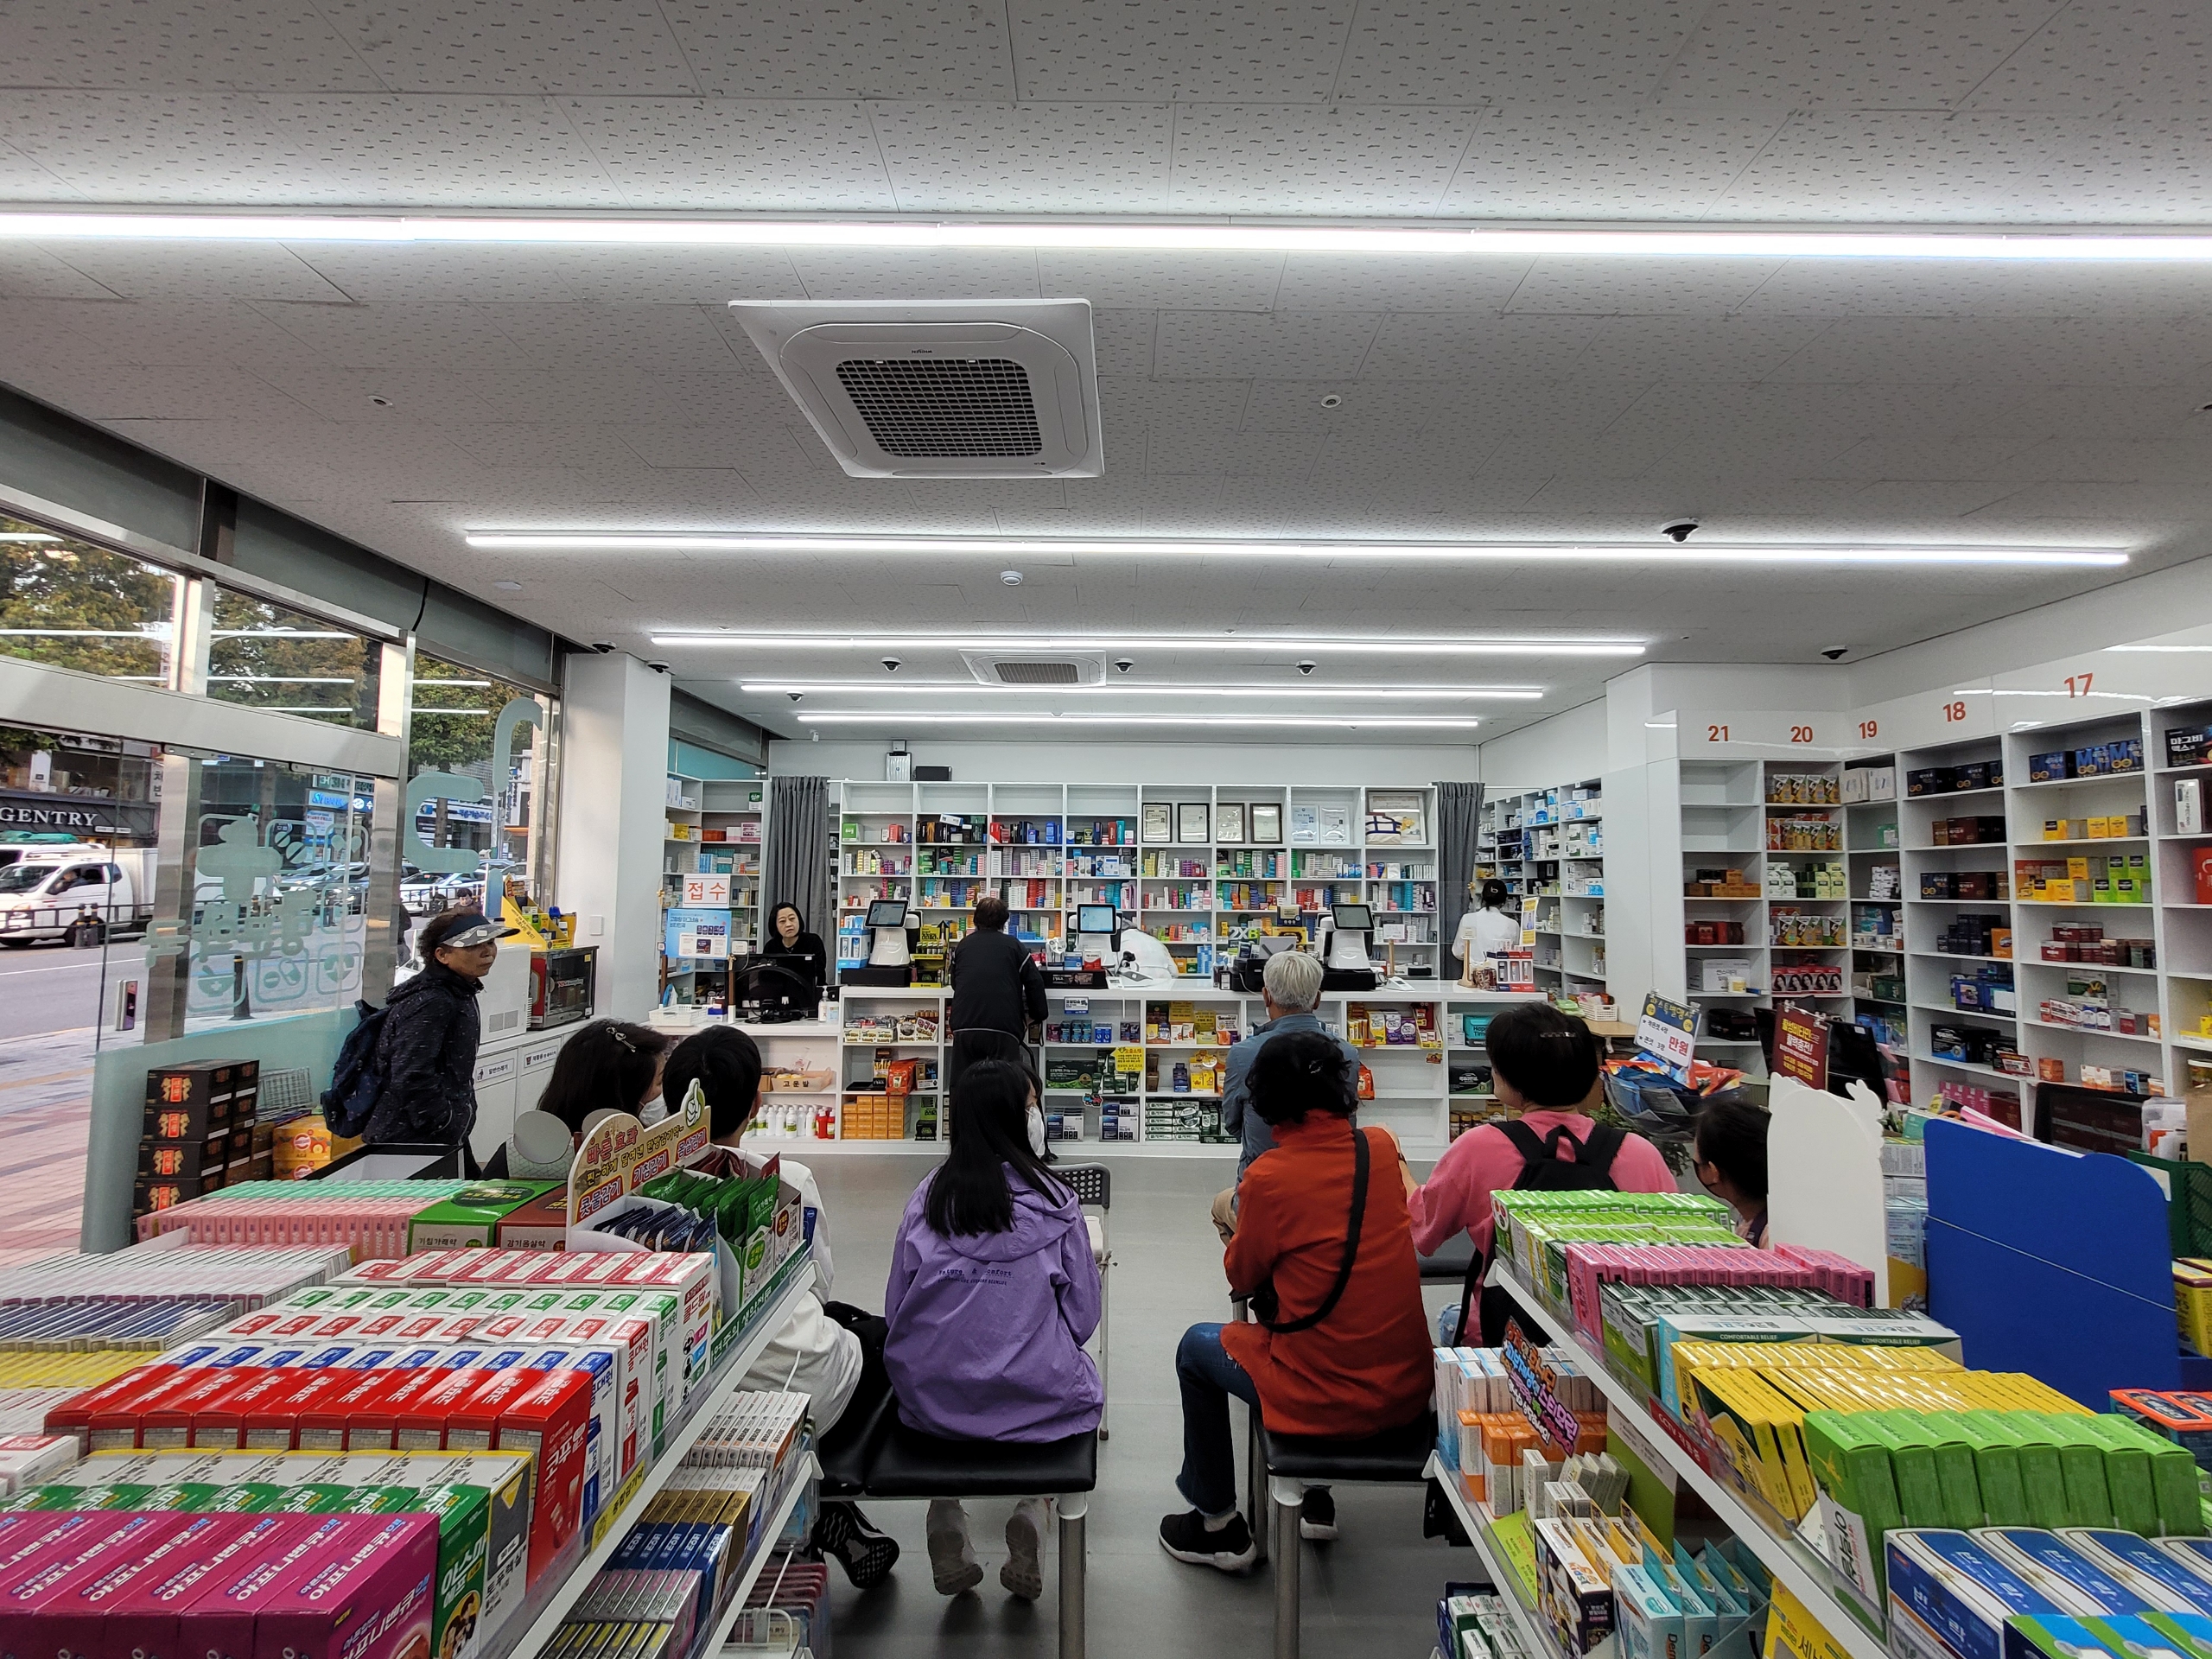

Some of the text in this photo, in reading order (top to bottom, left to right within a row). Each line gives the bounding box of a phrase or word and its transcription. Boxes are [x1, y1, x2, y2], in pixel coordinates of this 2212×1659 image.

[2063, 673, 2094, 699] 17
[1942, 702, 1967, 723] 18
[1707, 724, 1730, 742] 21
[1790, 725, 1814, 743] 20
[1859, 720, 1878, 739] 19
[2171, 734, 2203, 746] 마그비
[0, 807, 98, 827] GENTRY
[688, 882, 726, 900] 접수
[1669, 1036, 1689, 1057] 만원
[587, 1125, 639, 1165] 빠른 효과
[677, 1128, 706, 1159] 몸살감기
[620, 1144, 644, 1168] 달여낸
[633, 1152, 667, 1184] 기침감기
[580, 1176, 620, 1217] 콧물감기
[419, 1237, 457, 1247] 기침가래약
[1658, 1413, 1700, 1463] CCTV 작동중
[612, 1465, 645, 1516] 종합감기약
[1834, 1510, 1859, 1587] 아락실
[442, 1532, 486, 1596] 아스마
